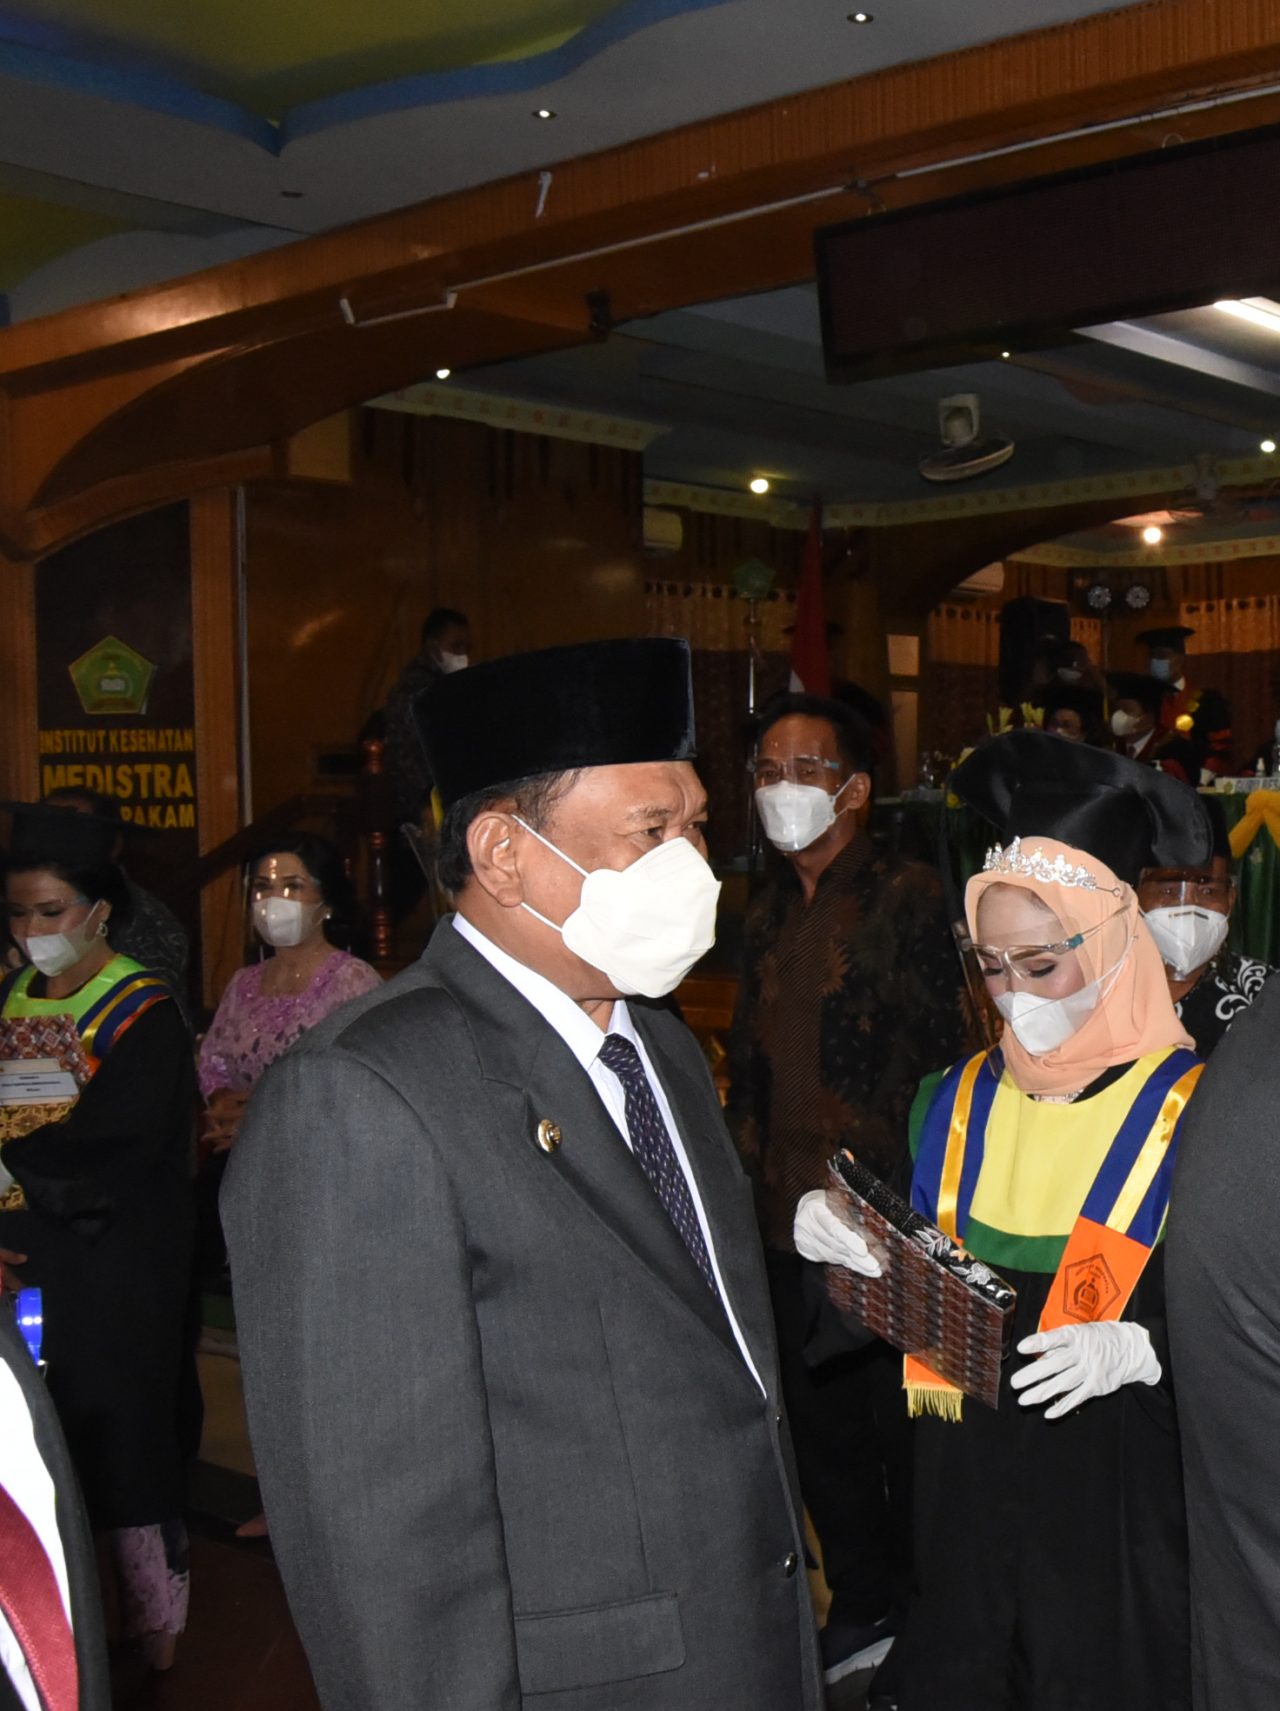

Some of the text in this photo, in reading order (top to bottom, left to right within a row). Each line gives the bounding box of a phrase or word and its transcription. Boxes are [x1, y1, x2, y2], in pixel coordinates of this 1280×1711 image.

[40, 728, 194, 753] INSTITUT KESEHATAN
[43, 761, 194, 799] MEDISTRA
[119, 803, 196, 829] PAKAM
